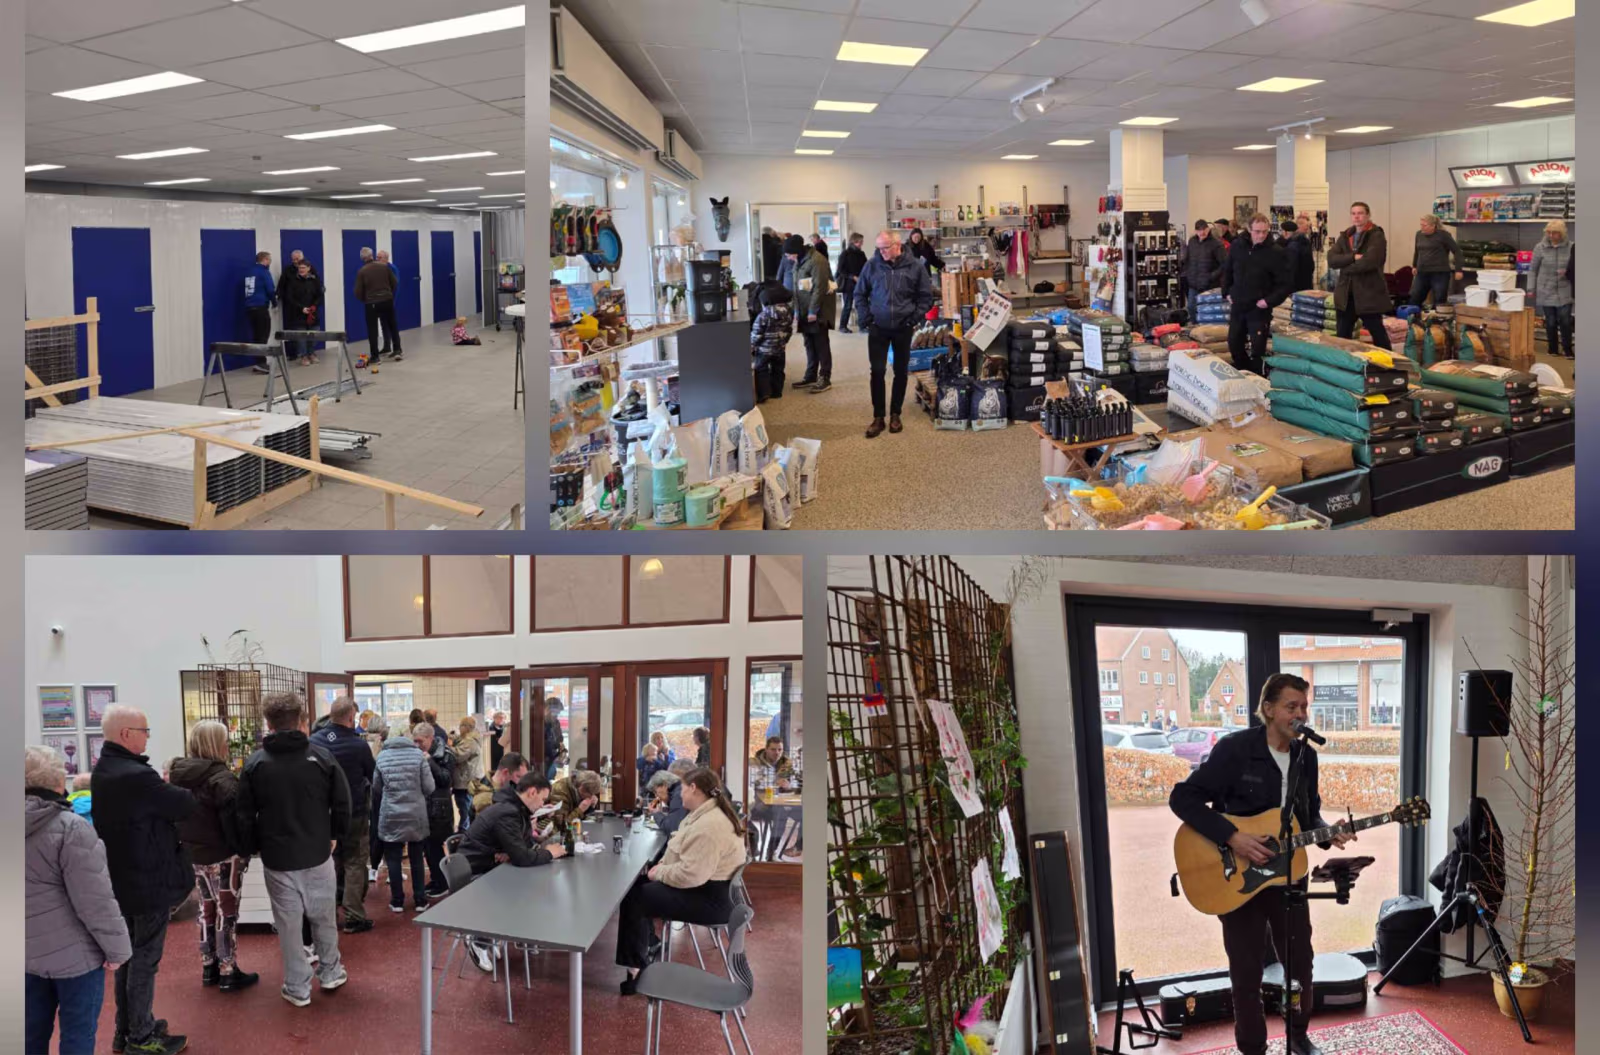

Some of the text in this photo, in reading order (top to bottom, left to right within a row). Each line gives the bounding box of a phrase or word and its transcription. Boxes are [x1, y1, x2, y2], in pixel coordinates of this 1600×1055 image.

[1462, 168, 1497, 181] ARION
[1529, 162, 1571, 177] ARION
[1473, 458, 1500, 475] NAG
